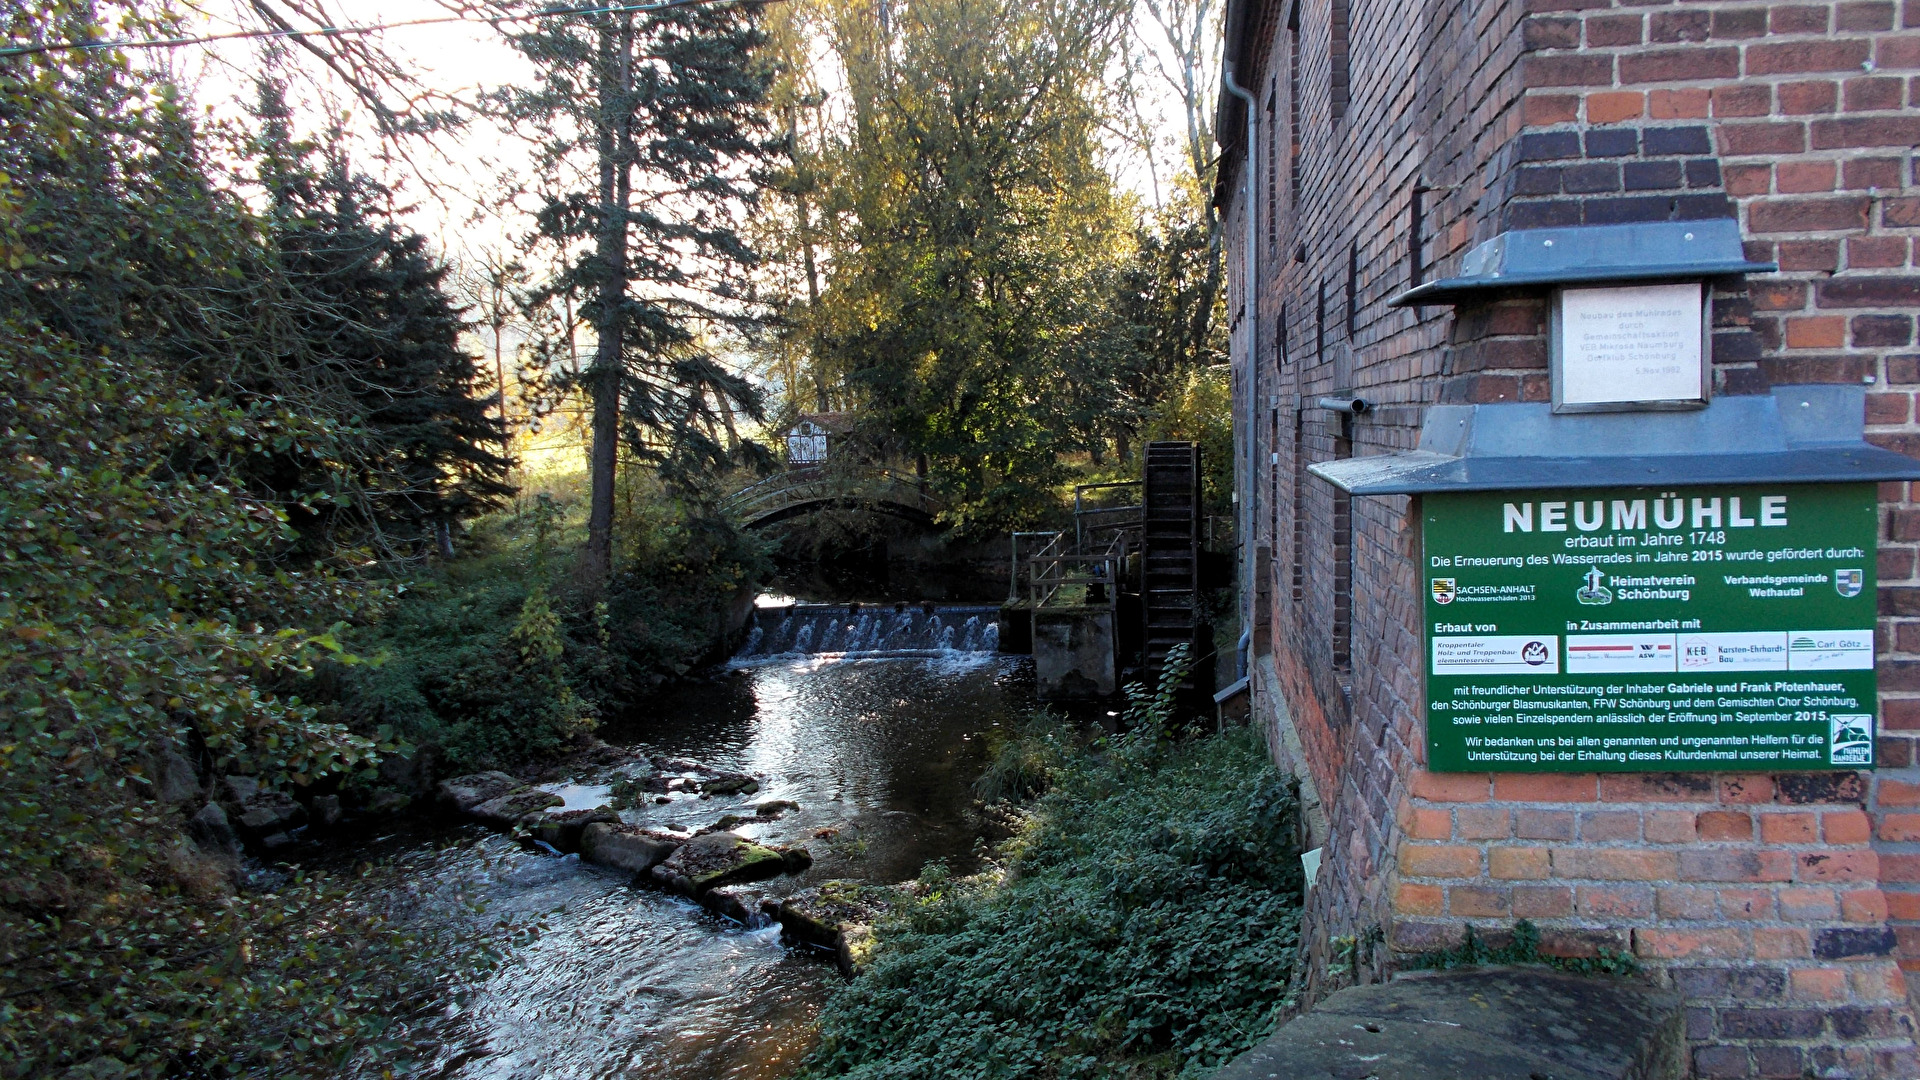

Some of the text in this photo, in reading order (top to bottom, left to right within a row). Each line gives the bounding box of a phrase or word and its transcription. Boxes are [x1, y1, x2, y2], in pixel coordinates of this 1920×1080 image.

[1584, 331, 1679, 340] Gemeinschaftsaktion
[1503, 492, 1788, 533] NEUMÜHLE
[1565, 532, 1726, 548] erbaut im Jahre 1748
[1431, 547, 1864, 567] Die Erneuerung des Wasserrades im Jahre 2015 wurde gefördert durch:
[1609, 575, 1695, 587] Heimatverein
[1724, 574, 1828, 585] Verbandsgemeinde
[1456, 586, 1535, 594] SACHSEN-ANHALT
[1617, 588, 1690, 600] Schönburg
[1749, 588, 1804, 597] Wethautal
[1434, 623, 1496, 632] Erbaut von
[1567, 619, 1701, 631] in Zusammenarbeit mit
[1719, 655, 1734, 663] Bau
[1454, 682, 1845, 696] mit freundlicher Unterstützung der Inhaber Gabriele und Frank Pfotenhauer,
[1432, 696, 1859, 711] den Schönburger Blasmusikanten, FFW Schönburg und dem Gemischten Chor Schönburg,
[1453, 711, 1829, 725] sowie vielen Einzelspendern anlässlich der Eröffnung im September 2015.
[1465, 734, 1823, 748] Wir bedanken uns bei allen genannten und ungenannten Helfern für die
[1468, 749, 1822, 762] Unterstützung bei der Erhaltung dieses Kulturdenkmal unserer Heimat.
